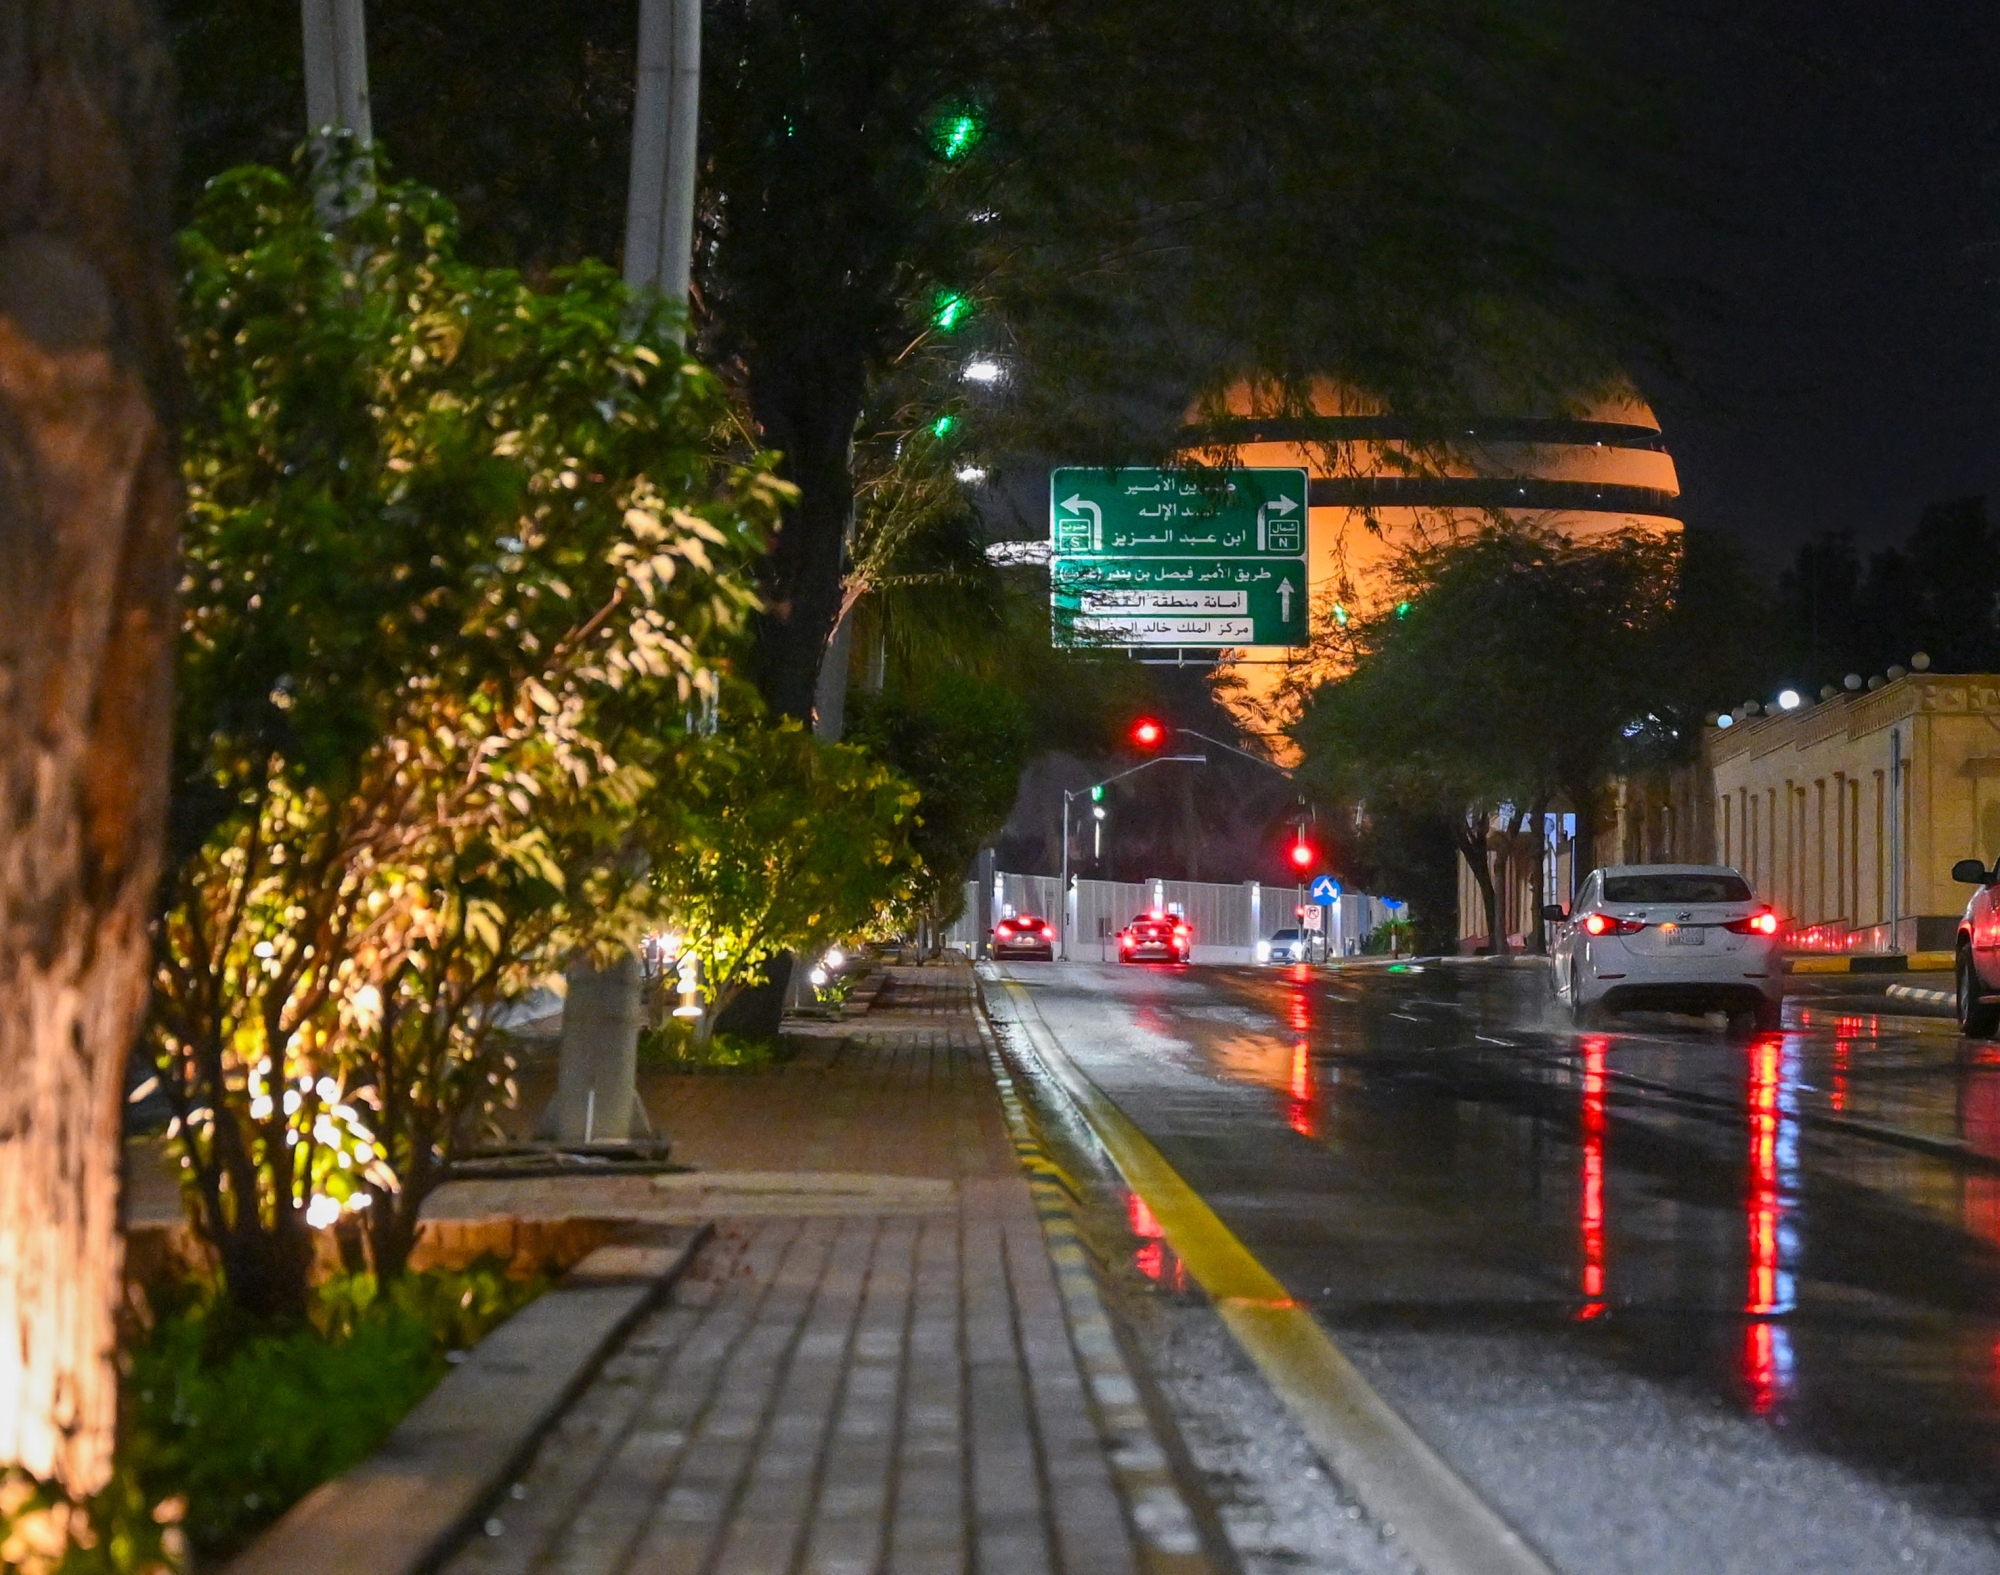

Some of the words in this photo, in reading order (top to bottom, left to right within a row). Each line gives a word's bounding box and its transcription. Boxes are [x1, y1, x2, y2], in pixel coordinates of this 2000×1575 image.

[1124, 473, 1176, 495] الأمير
[1138, 503, 1178, 521] الإله
[1271, 522, 1296, 534] شمال
[1069, 536, 1081, 548] S
[1111, 529, 1173, 547] العزيز
[1179, 533, 1217, 547] عبد
[1222, 529, 1247, 547] ابن
[1278, 536, 1289, 548] N
[1134, 568, 1151, 582] بن
[1154, 566, 1194, 582] فيصل
[1197, 562, 1231, 582] الأمير
[1234, 567, 1272, 583] طريق
[1152, 595, 1198, 608] منطقة
[1203, 592, 1241, 608] أمانة
[1143, 621, 1172, 634] خالد
[1176, 621, 1211, 634] الملك
[1218, 621, 1249, 636] مركز
